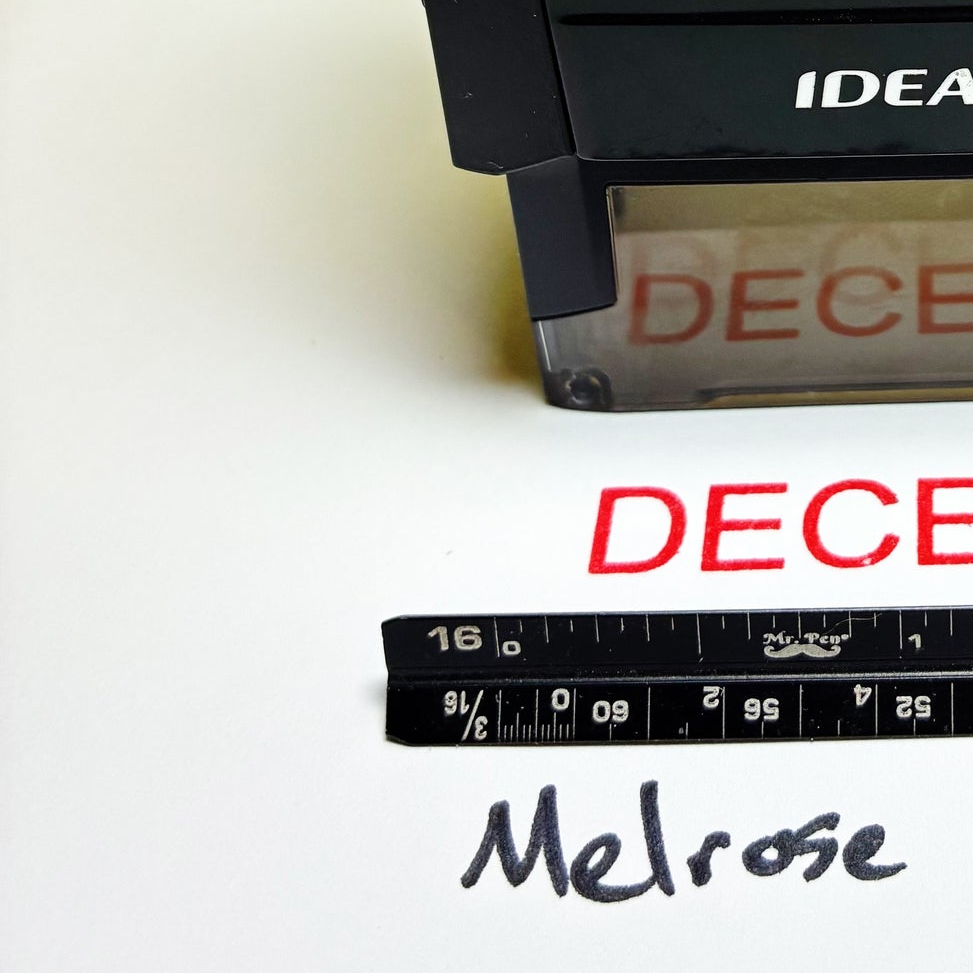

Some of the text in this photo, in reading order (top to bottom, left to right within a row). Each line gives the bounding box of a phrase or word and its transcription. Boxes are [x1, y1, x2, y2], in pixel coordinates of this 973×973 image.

[427, 625, 483, 651] 16
[502, 640, 521, 655] 0
[763, 630, 800, 644] Mr.
[907, 633, 922, 649] 1
[551, 687, 570, 711] 0
[702, 685, 719, 708] 2
[853, 683, 872, 707] 4
[592, 699, 629, 723] 60
[743, 697, 780, 721] 56
[895, 695, 932, 719] 52
[460, 780, 908, 904] Melrose
